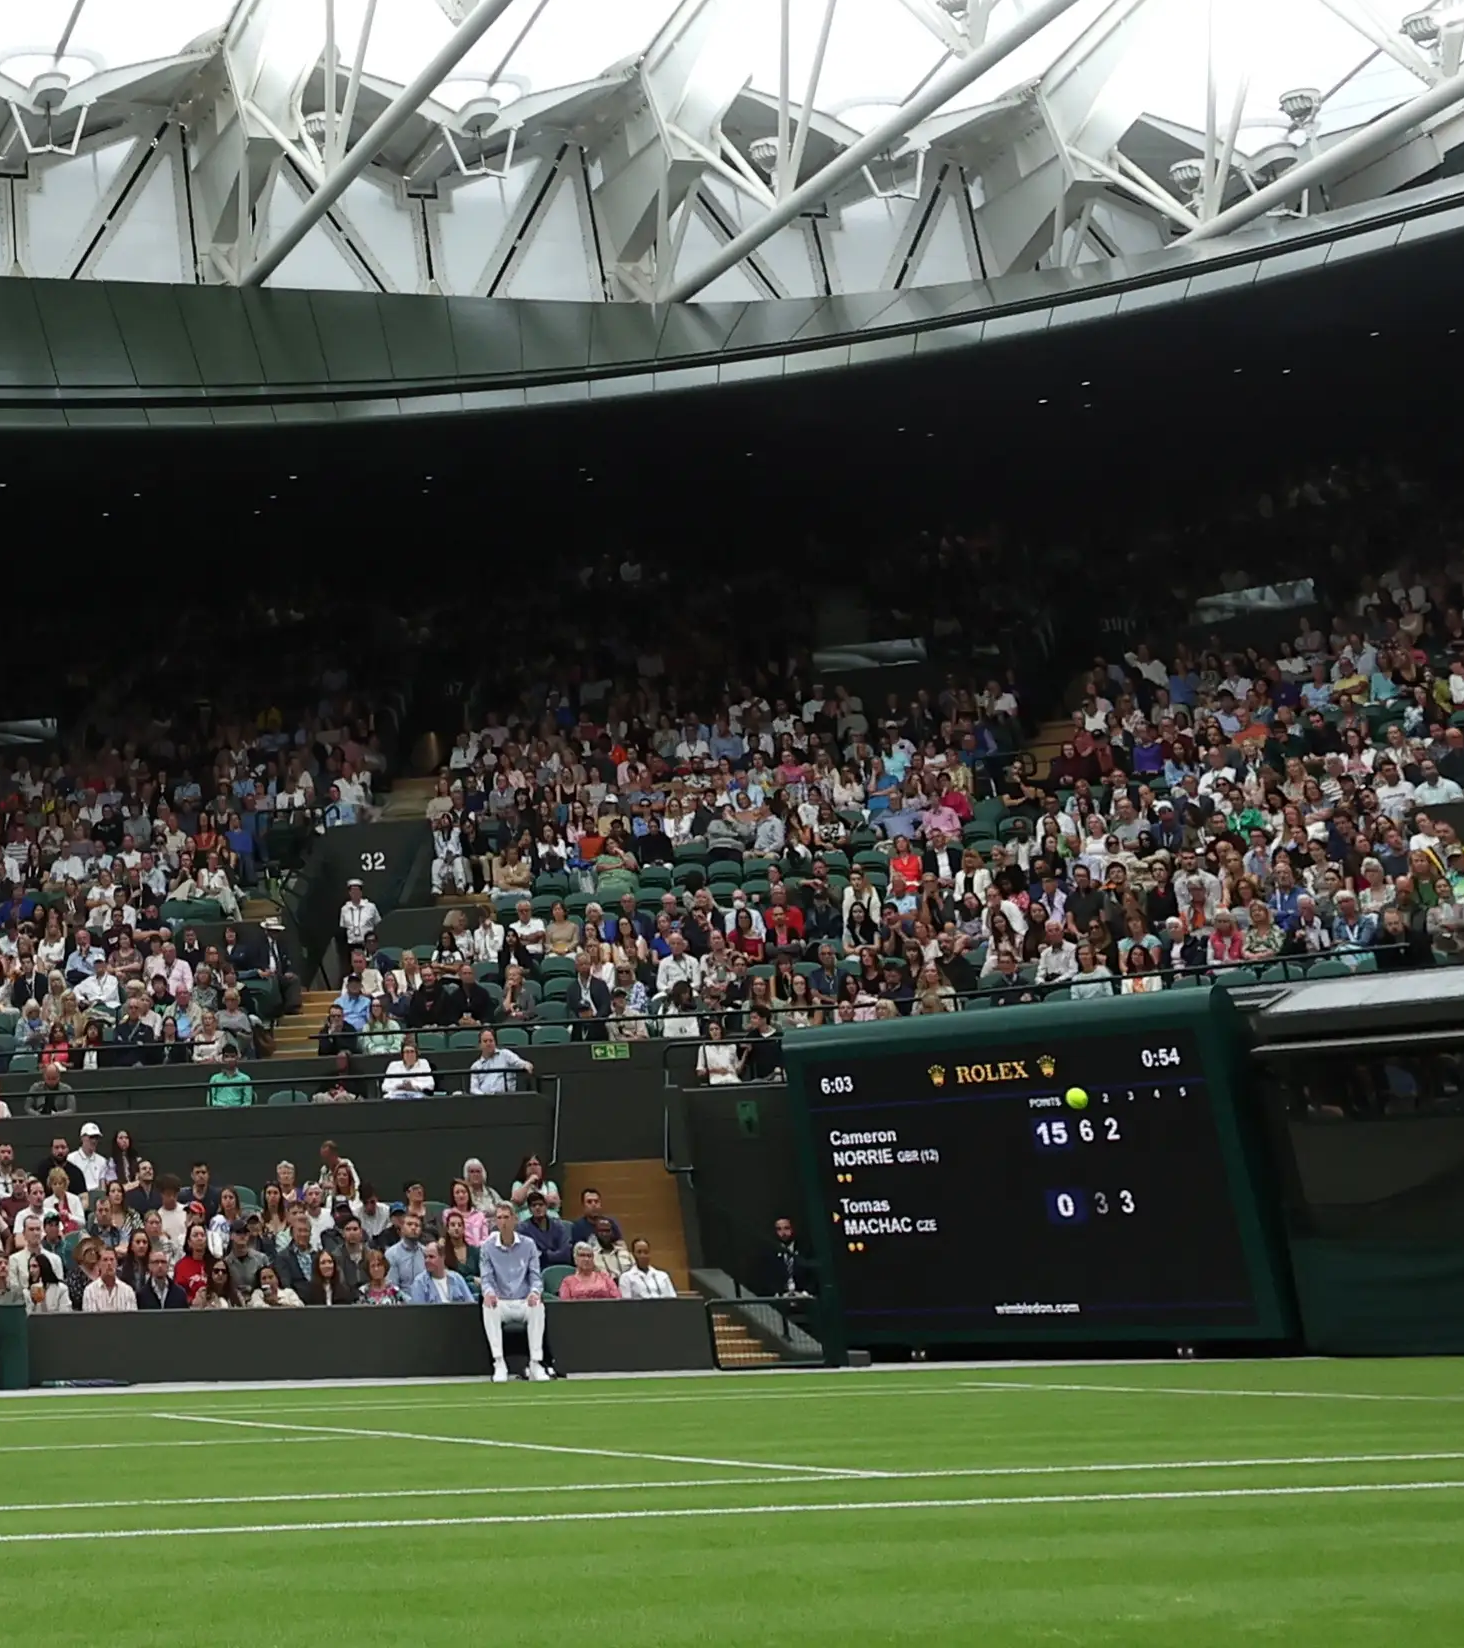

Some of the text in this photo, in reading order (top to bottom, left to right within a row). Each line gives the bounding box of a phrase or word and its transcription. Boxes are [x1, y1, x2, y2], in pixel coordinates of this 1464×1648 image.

[360, 851, 386, 871] 32
[1141, 1047, 1181, 1068] 0:54
[955, 1060, 1029, 1084] ROLEX
[820, 1075, 854, 1094] 6:03
[1028, 1086, 1187, 1109] POINTS 2 3 4 5
[830, 1130, 897, 1146] Cameron
[1036, 1117, 1121, 1145] 15 6 2
[833, 1148, 939, 1167] NORRIE GBR (12)
[840, 1198, 891, 1215] Tomas
[1057, 1189, 1135, 1217] 0 3 3
[843, 1217, 938, 1236] MACHAC CZE
[995, 1301, 1080, 1315] wimbledon.com
